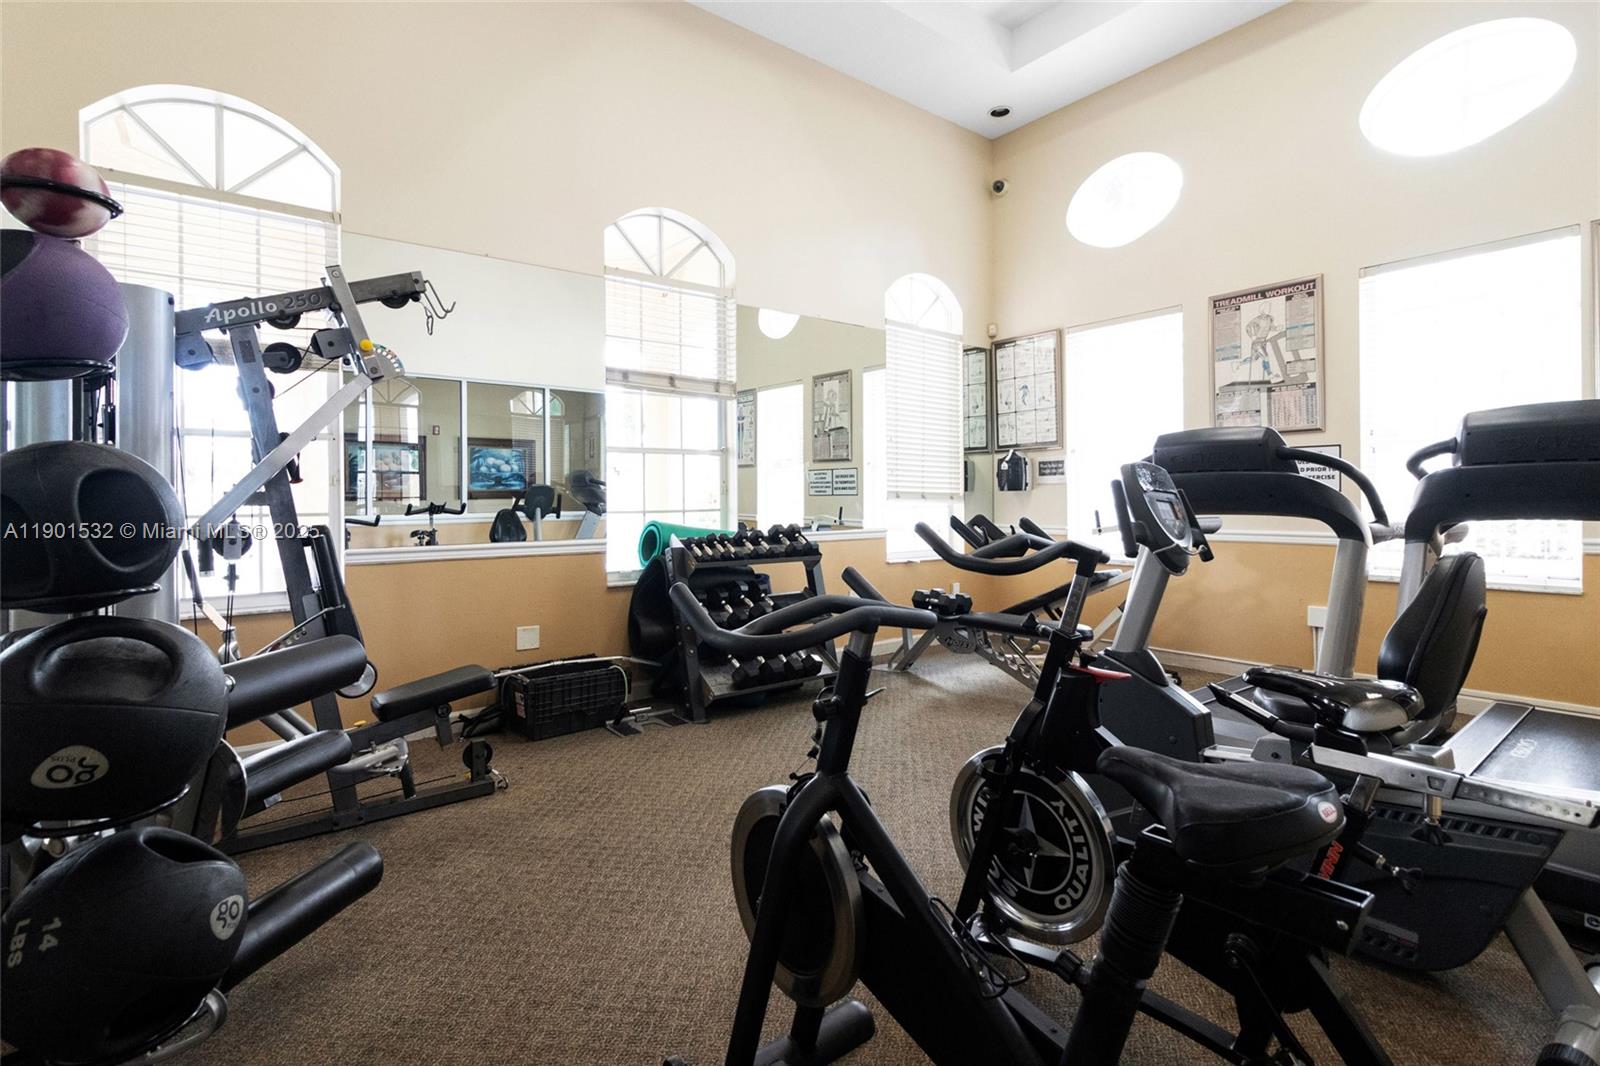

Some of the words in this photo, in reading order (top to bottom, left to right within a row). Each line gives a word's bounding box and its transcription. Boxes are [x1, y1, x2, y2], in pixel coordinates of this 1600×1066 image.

[204, 300, 278, 324] Apollo
[282, 293, 321, 311] 250
[1214, 293, 1264, 309] TREADMILL
[1265, 282, 1315, 299] WORKOUT
[1051, 799, 1090, 911] QUALITY
[7, 918, 31, 968] LBS
[38, 917, 62, 952] 14
